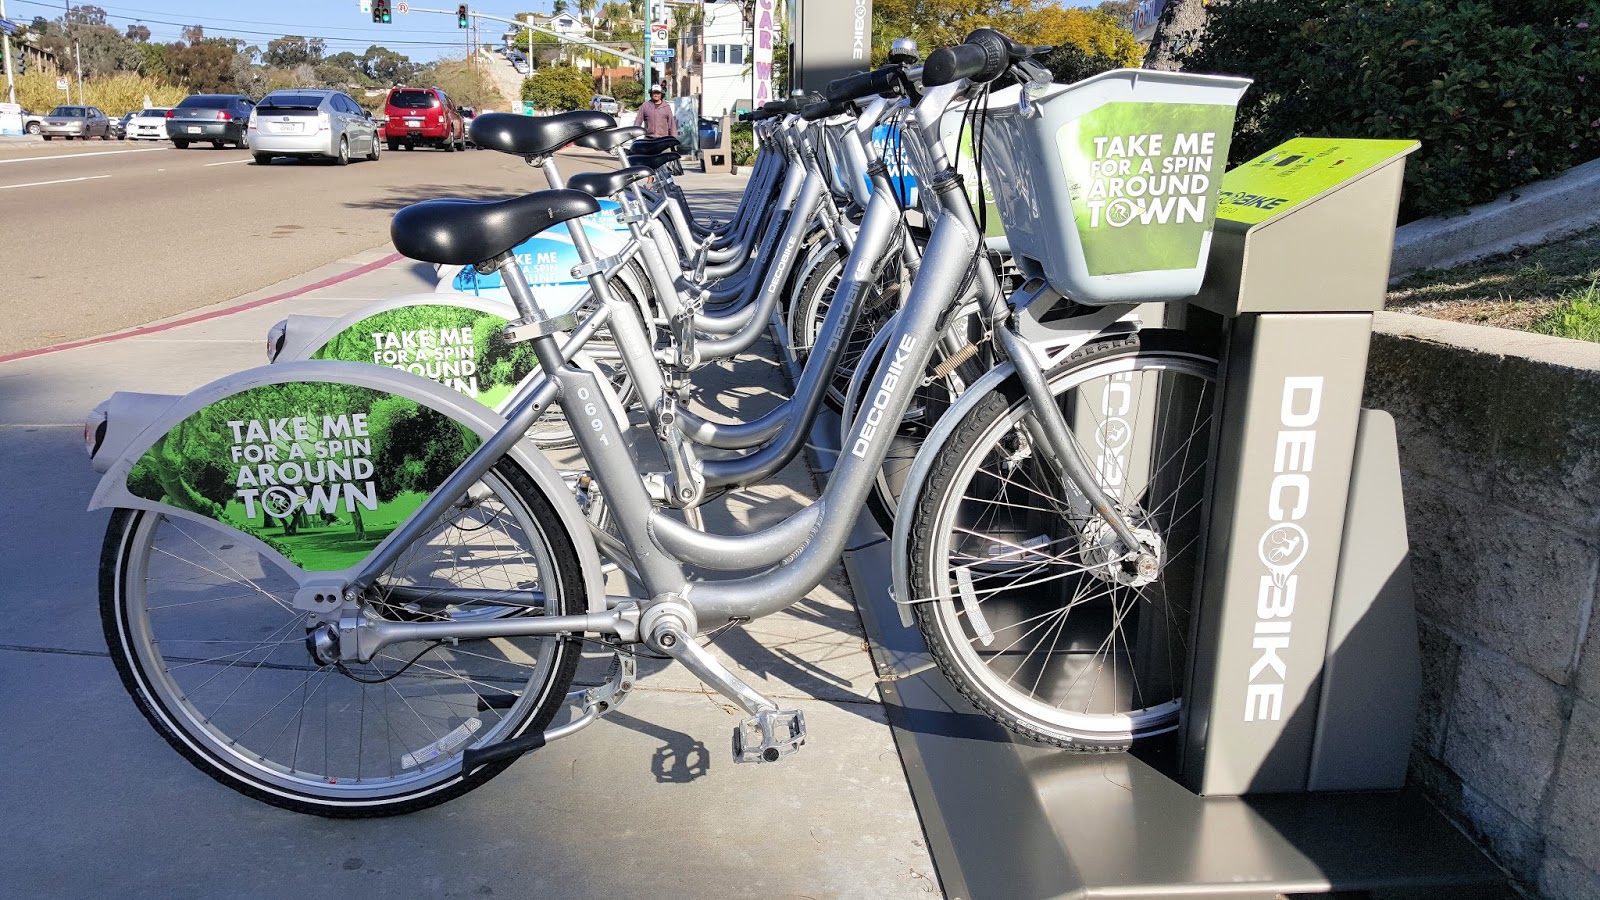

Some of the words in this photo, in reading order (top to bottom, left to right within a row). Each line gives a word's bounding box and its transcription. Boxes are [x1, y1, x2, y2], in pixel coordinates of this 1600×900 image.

[1093, 134, 1163, 159] TAKE
[1172, 132, 1216, 155] ME
[1090, 159, 1131, 177] FOR
[1138, 158, 1154, 174] A
[1161, 156, 1212, 174] SPIN
[1088, 174, 1210, 199] AROUND
[1087, 195, 1206, 228] TOWN
[534, 264, 558, 274] SPIN
[537, 252, 558, 264] ME
[768, 236, 797, 294] DECOBIKE
[826, 260, 867, 354] DECOBIKE
[372, 330, 430, 350] TAKE
[440, 327, 473, 345] ME
[374, 350, 410, 364] FOR
[416, 349, 428, 361] A
[434, 346, 474, 360] SPIN
[392, 360, 476, 379] OUND
[852, 333, 917, 458] DECOBIKE
[227, 416, 309, 444] TAKE
[323, 413, 370, 439] ME
[577, 387, 610, 447] 0691
[231, 444, 279, 463] FOR
[288, 442, 306, 460] A
[314, 438, 371, 459] SPIN
[236, 458, 374, 487] AROUND
[237, 481, 378, 519] TOWN
[1244, 376, 1324, 722] DECOBIKE
